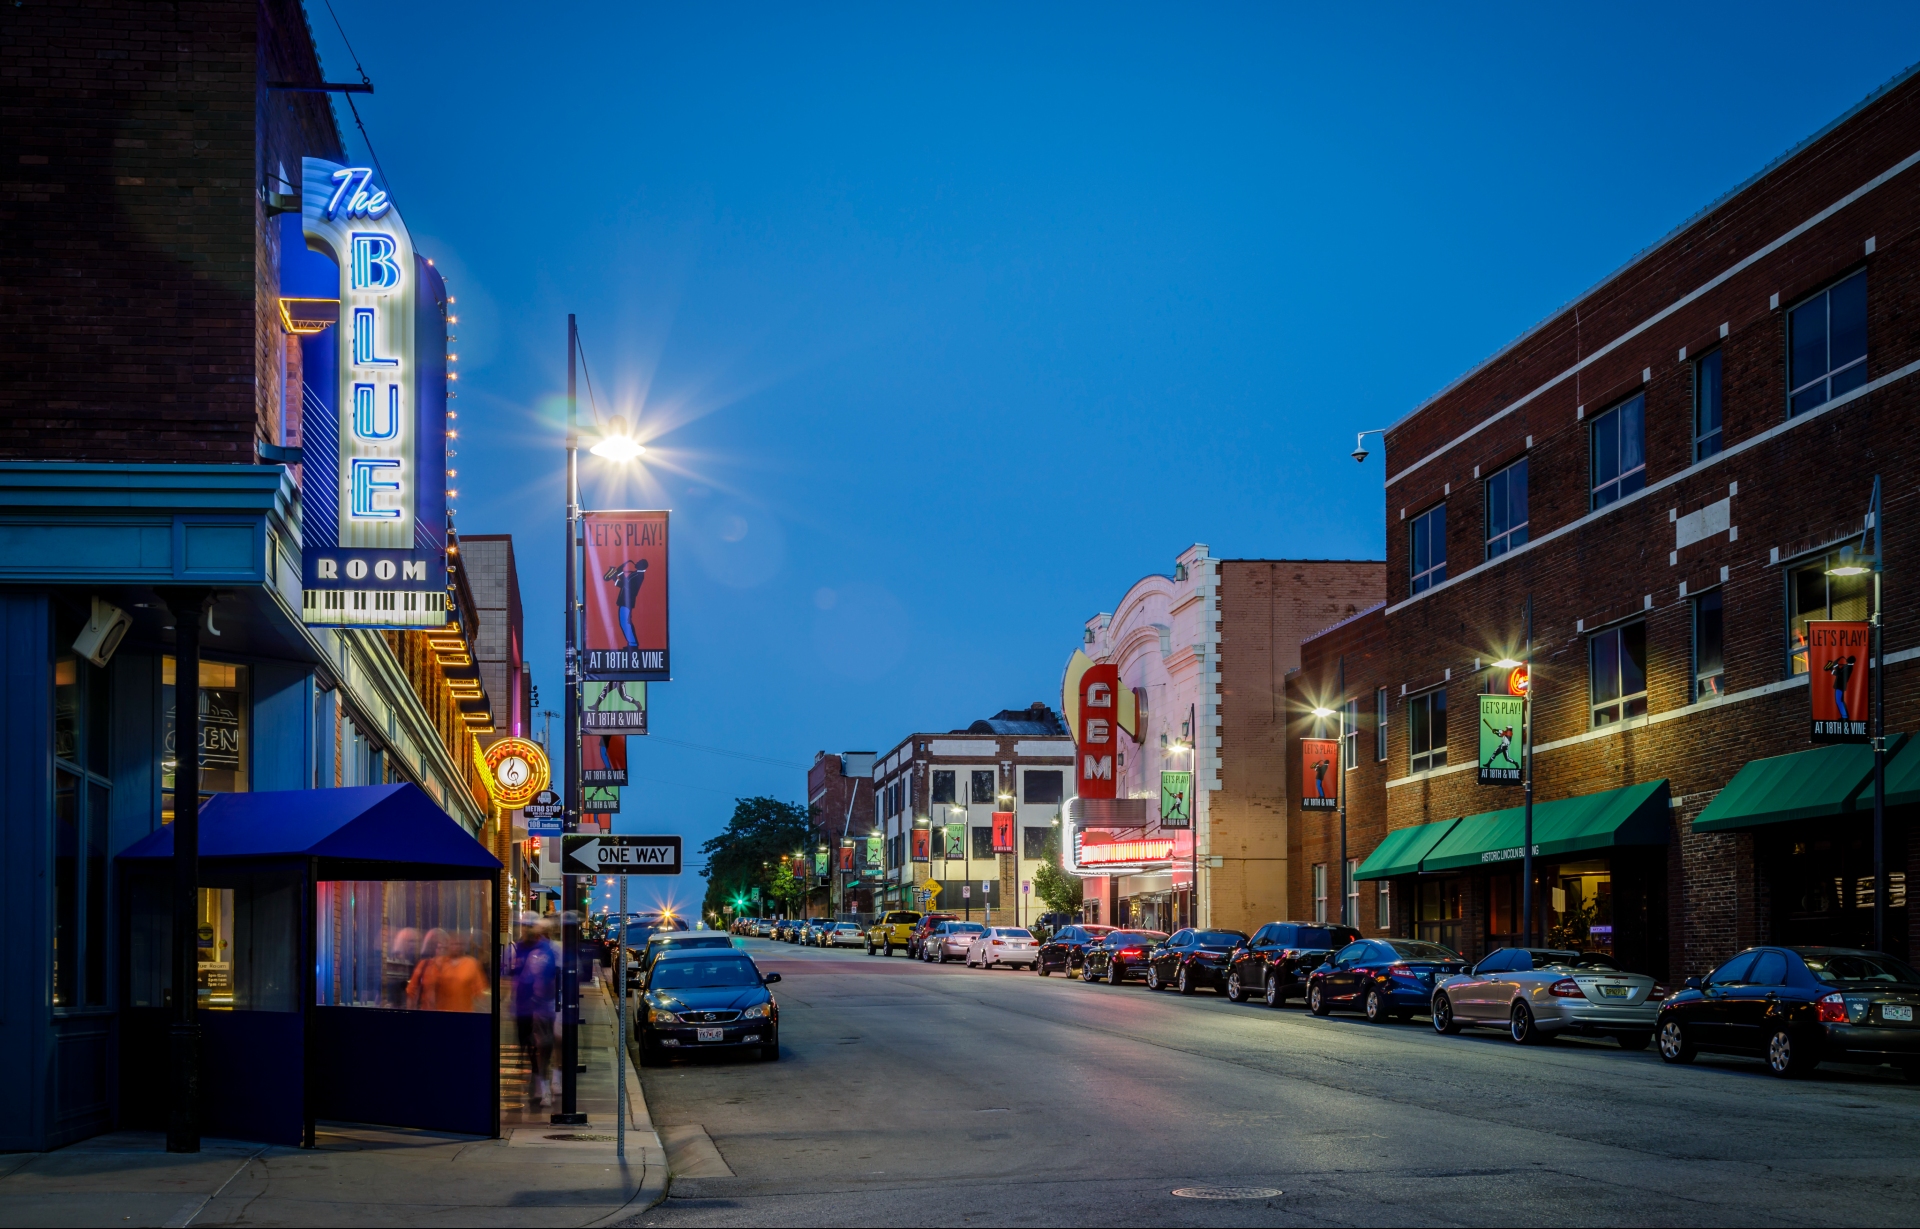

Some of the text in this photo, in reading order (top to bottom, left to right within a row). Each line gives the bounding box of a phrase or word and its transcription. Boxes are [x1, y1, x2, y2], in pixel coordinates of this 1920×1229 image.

[327, 168, 391, 221] The
[350, 230, 403, 520] BLUE
[588, 523, 663, 547] LET'S PLAY!
[318, 559, 426, 581] ROOM
[1812, 630, 1866, 646] LET'S PLAY!
[590, 652, 664, 669] AT 18TH & VINE
[1482, 702, 1520, 714] LET'S PLAY!
[586, 712, 643, 726] AT 18TH & VINE
[1083, 682, 1112, 780] GEM
[1815, 722, 1866, 734] AT 18TH & VINE
[1304, 744, 1336, 754] LET'S PLAY!
[584, 770, 624, 780] AT 18TH & VINE
[1164, 775, 1188, 784] LET'S PLAY!
[1481, 769, 1520, 780] AT 18TH & VINE
[501, 779, 536, 800] SHOP
[1304, 798, 1310, 806] AT
[1310, 798, 1320, 806] 18TH
[1326, 798, 1336, 806] VINE
[598, 848, 668, 863] ONE WAY
[1482, 845, 1539, 862] HISTORIC LINCOLN BUNG
